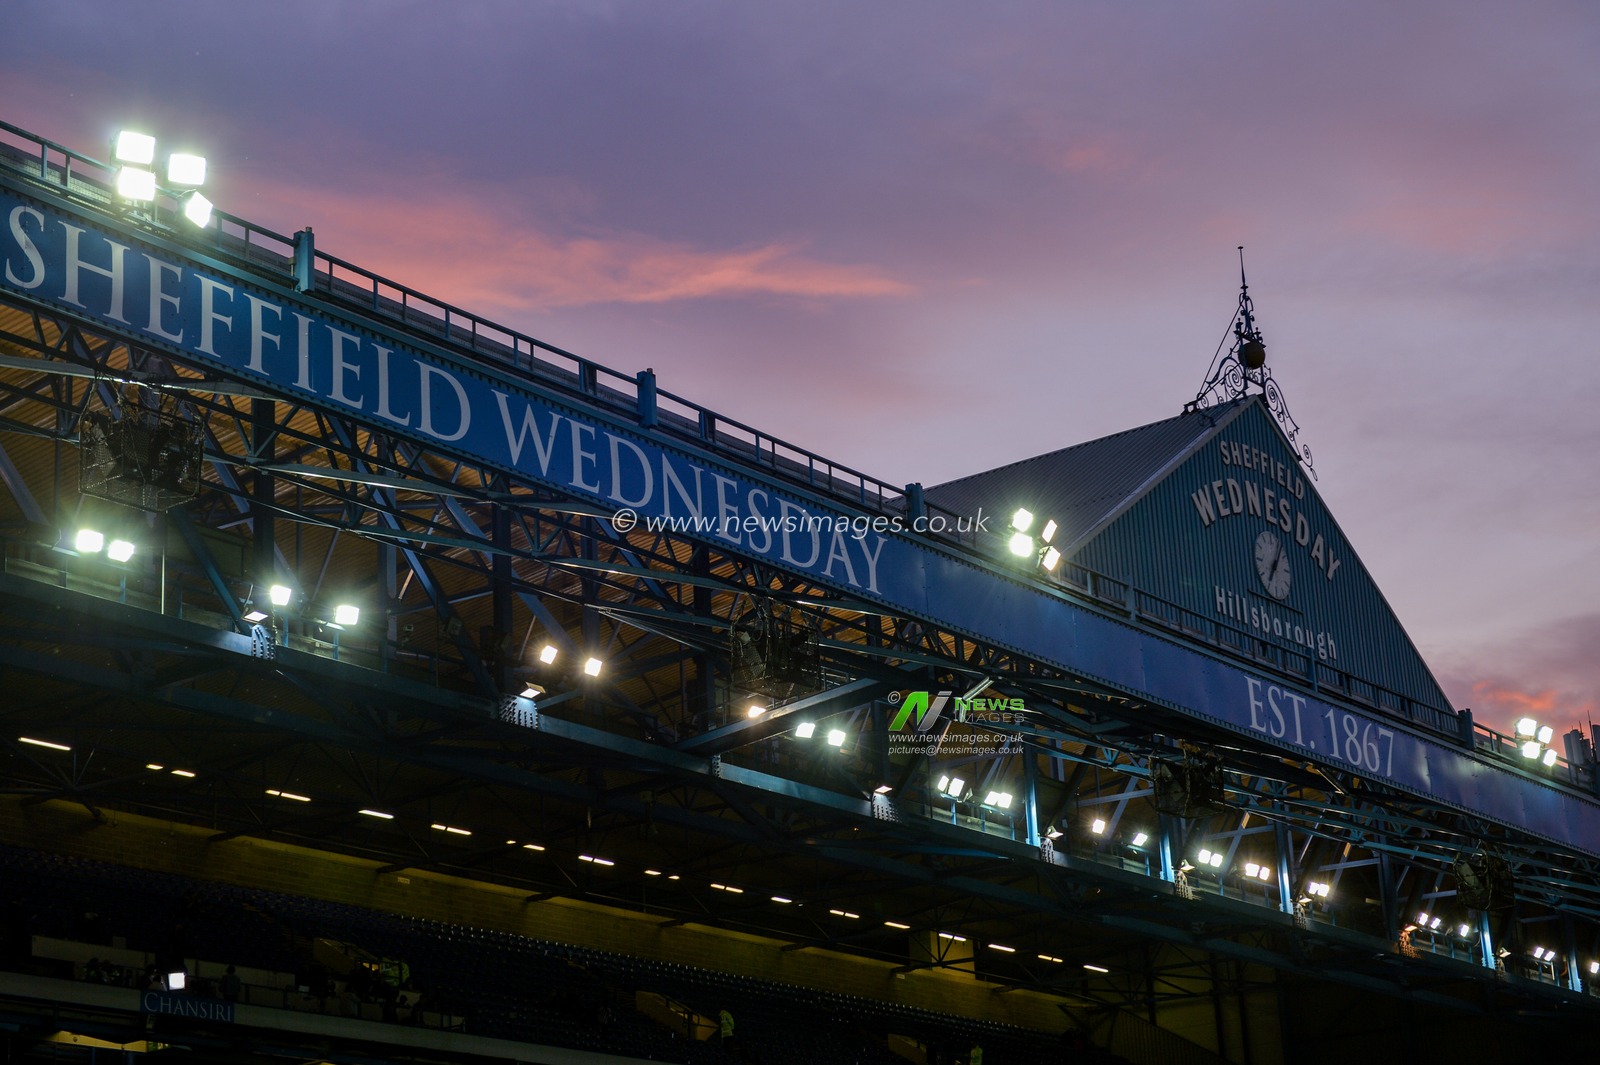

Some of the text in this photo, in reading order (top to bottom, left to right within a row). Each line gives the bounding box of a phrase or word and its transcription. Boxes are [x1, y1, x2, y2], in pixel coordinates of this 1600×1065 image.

[5, 205, 887, 595] SHEFFIELD WEDNESDAY
[1220, 440, 1304, 500] SHEFFIELD
[1191, 478, 1341, 581] WEDNESDAY
[1215, 585, 1337, 660] Hillsborough
[1243, 675, 1394, 777] EST. 1867
[144, 992, 231, 1022] CHANSIRI
